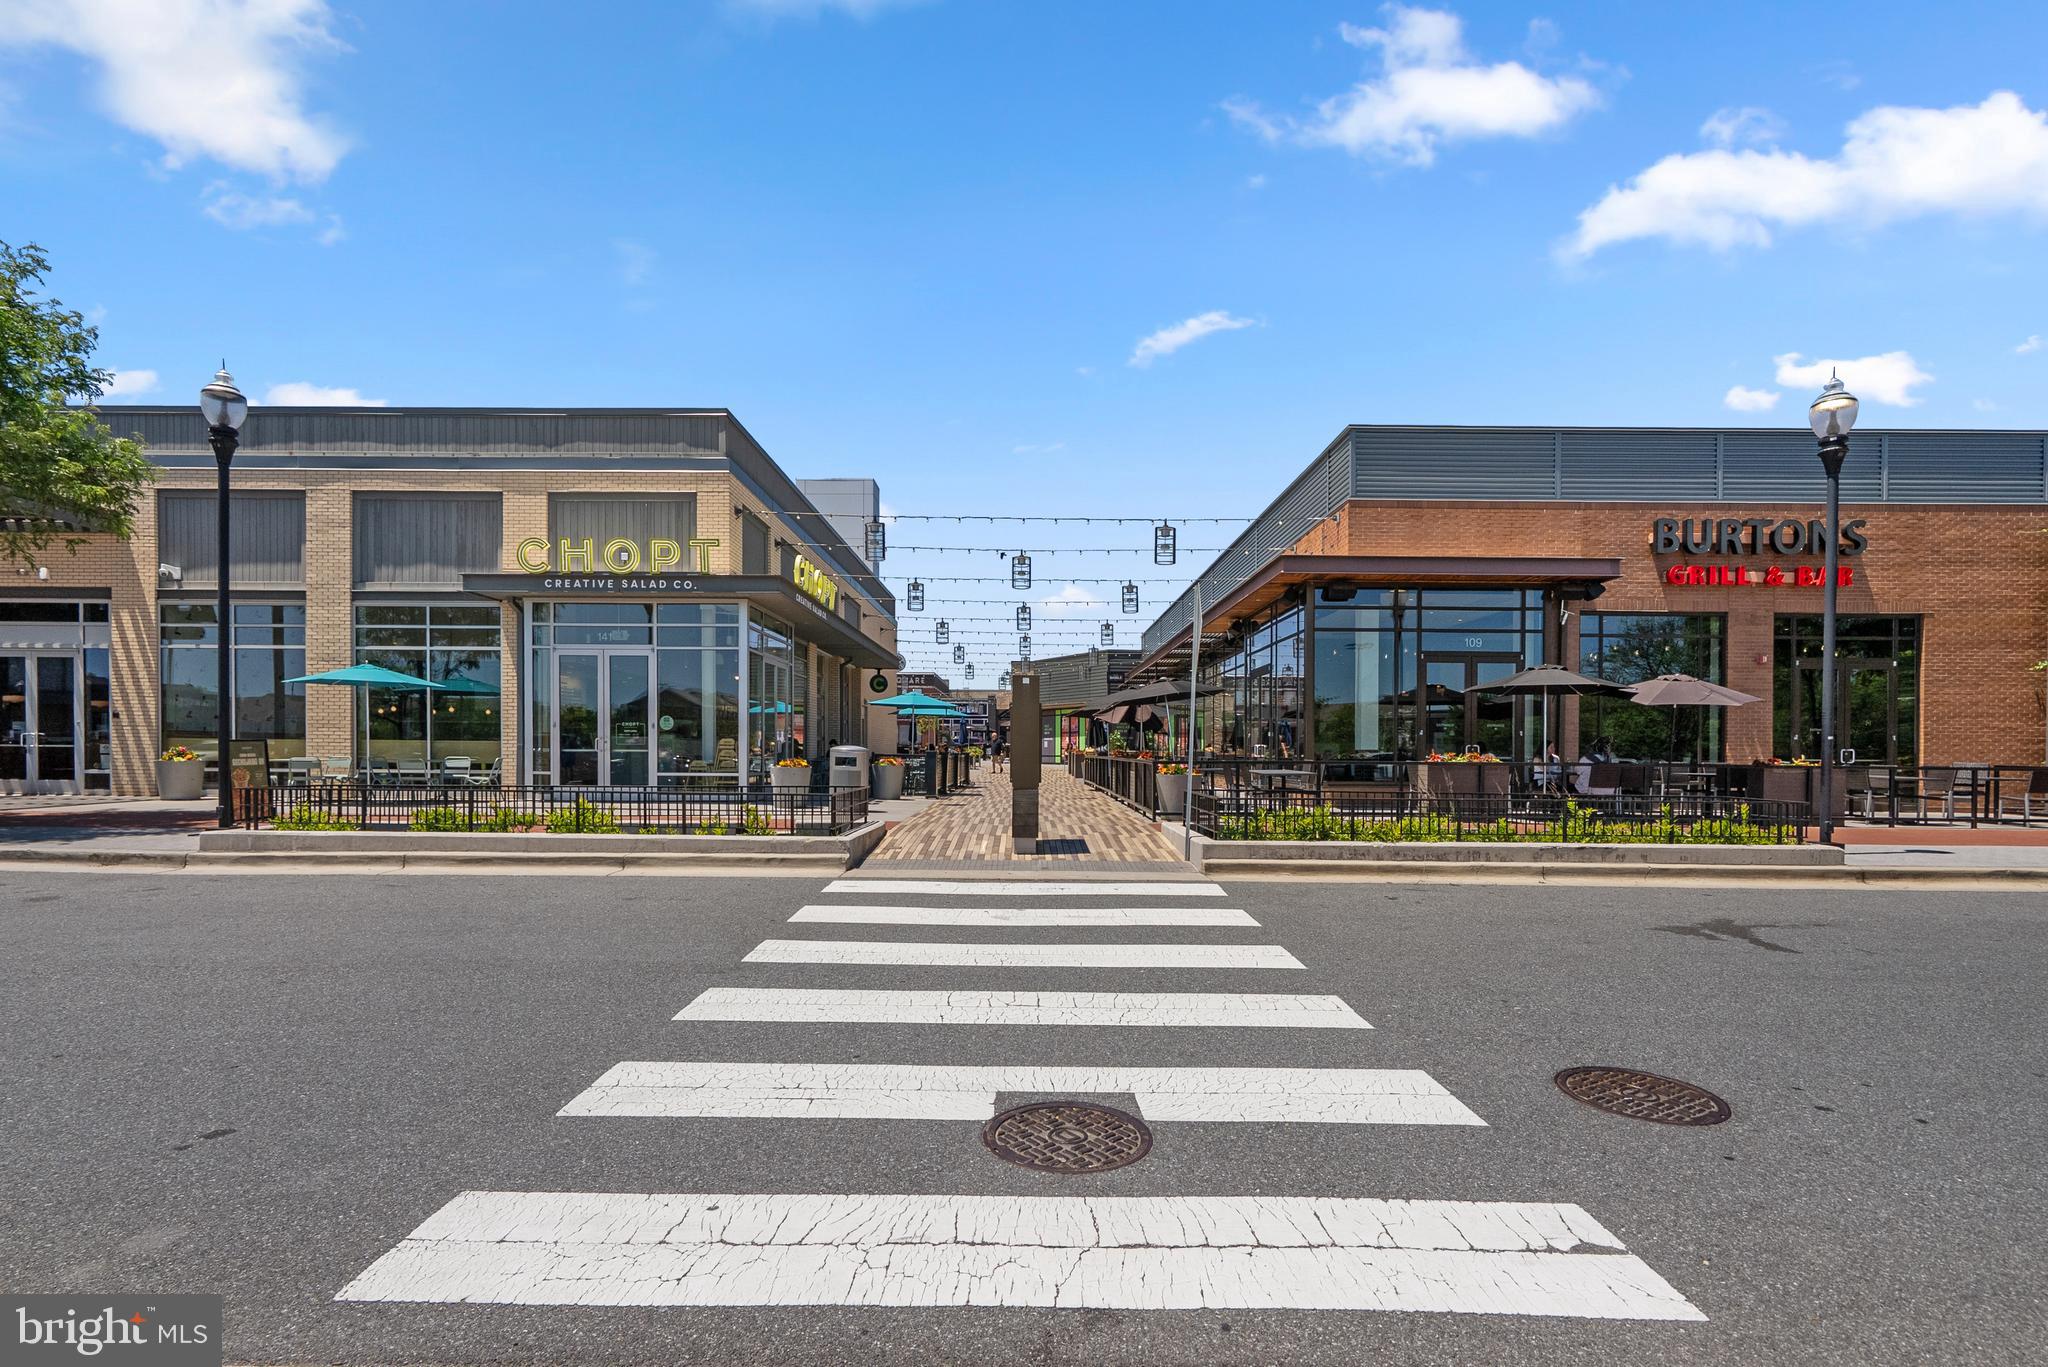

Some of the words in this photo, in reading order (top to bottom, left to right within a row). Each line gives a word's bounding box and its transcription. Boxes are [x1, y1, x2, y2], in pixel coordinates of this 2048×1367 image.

[516, 537, 720, 575] CHOPT
[544, 578, 614, 588] CREATIVE
[621, 579, 667, 589] SALAD
[673, 580, 697, 590] CO.
[793, 554, 838, 610] CHOPT
[1665, 564, 1752, 586] GRILL
[1763, 565, 1785, 586] &
[1464, 637, 1483, 648] 109
